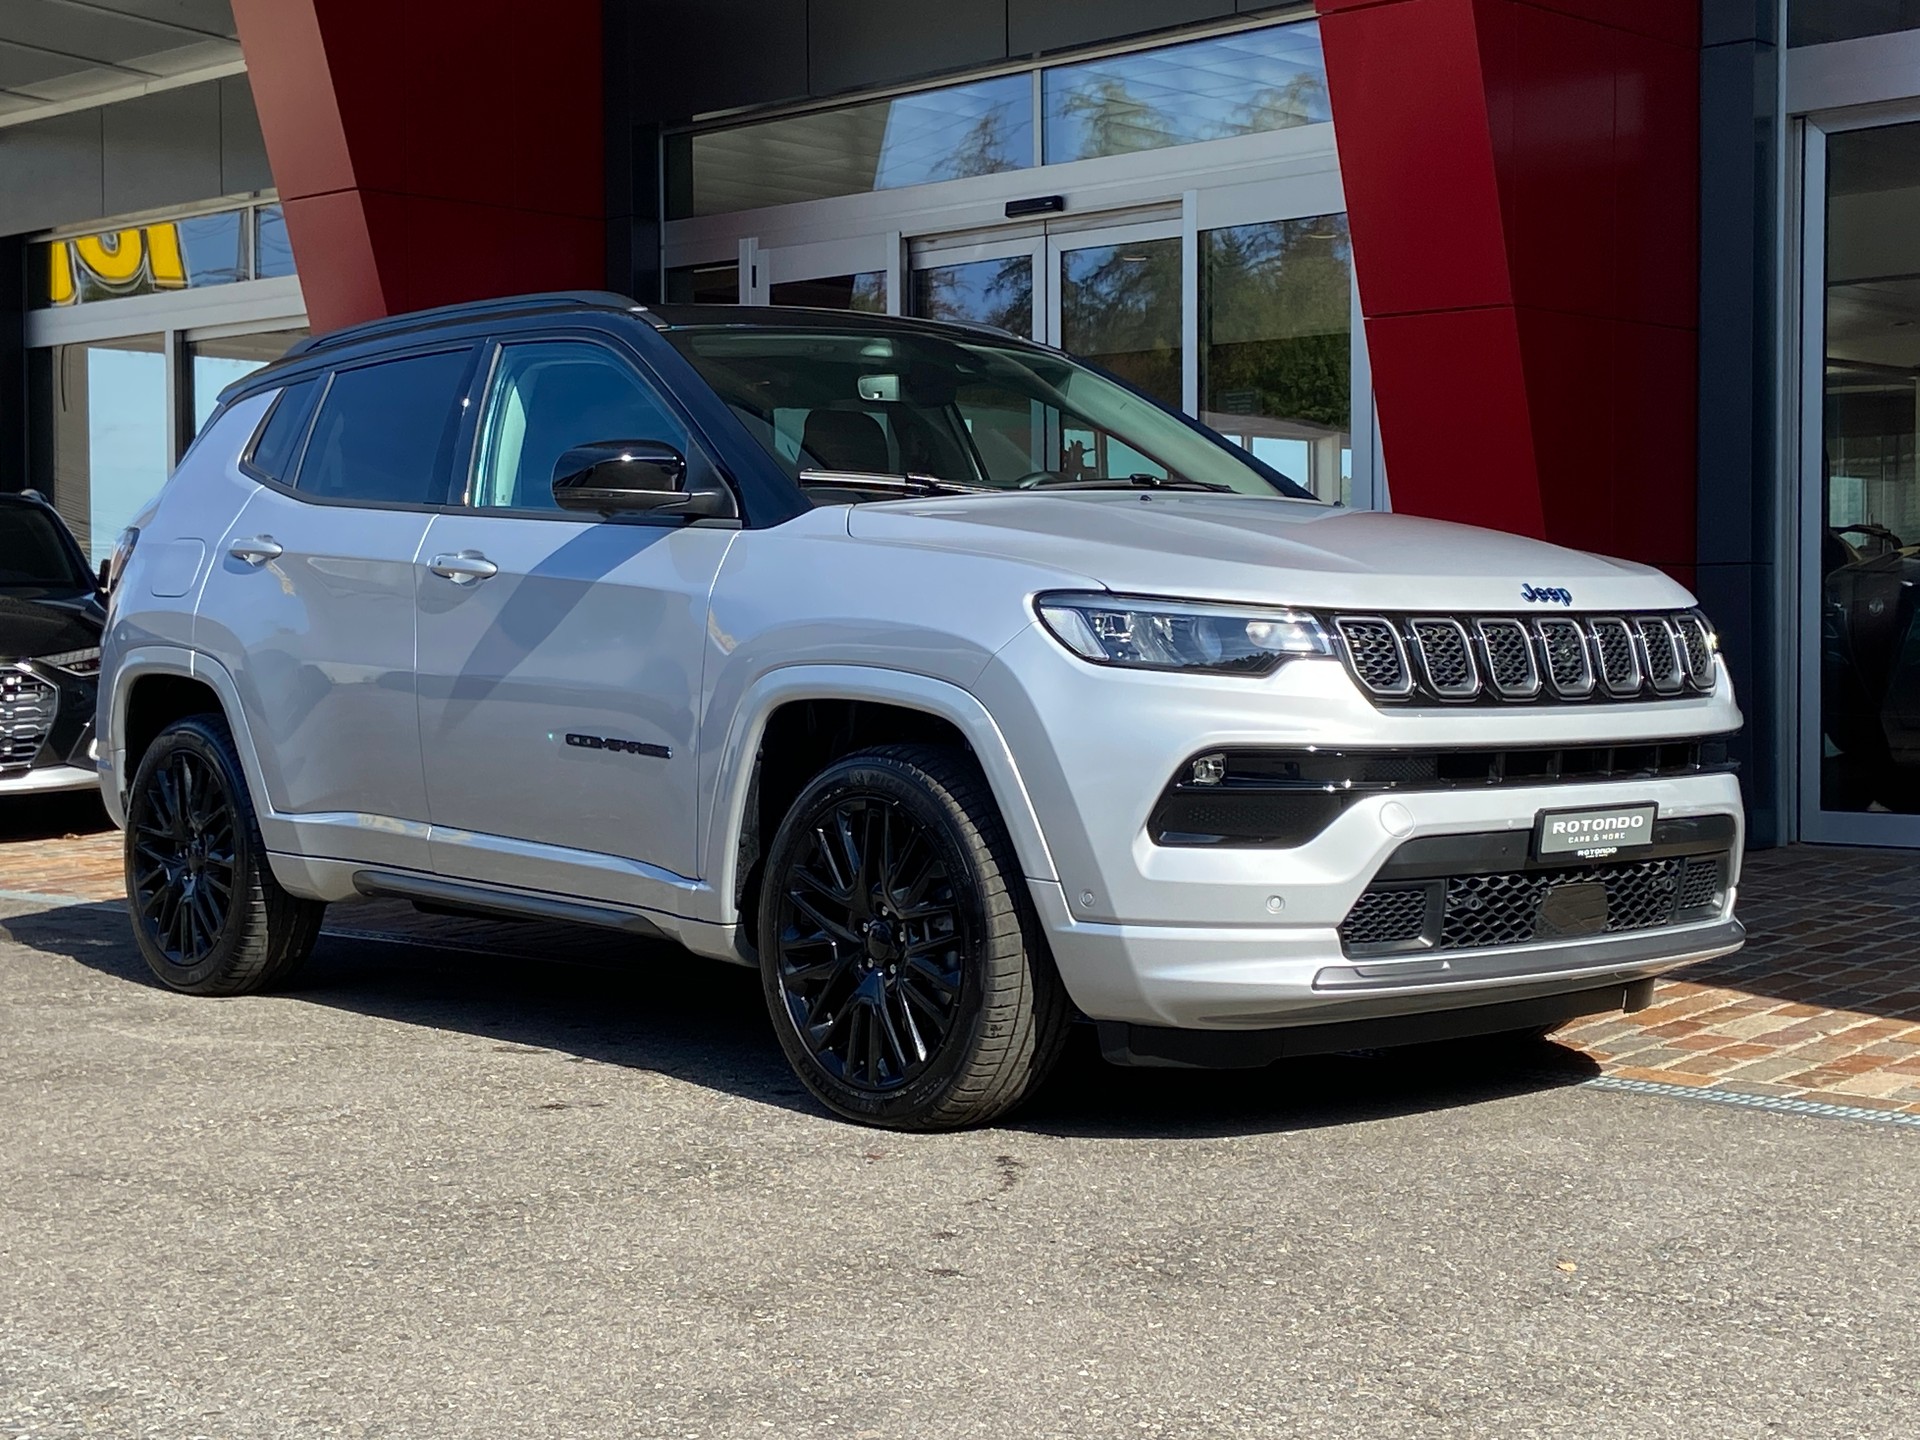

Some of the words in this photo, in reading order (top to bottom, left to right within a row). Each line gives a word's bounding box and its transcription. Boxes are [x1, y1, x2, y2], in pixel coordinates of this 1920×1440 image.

[1520, 582, 1573, 607] Jeep
[1552, 815, 1644, 834] ROTONDO
[1568, 835, 1590, 844] CARS
[1593, 834, 1600, 842] &
[1602, 832, 1626, 840] MORE
